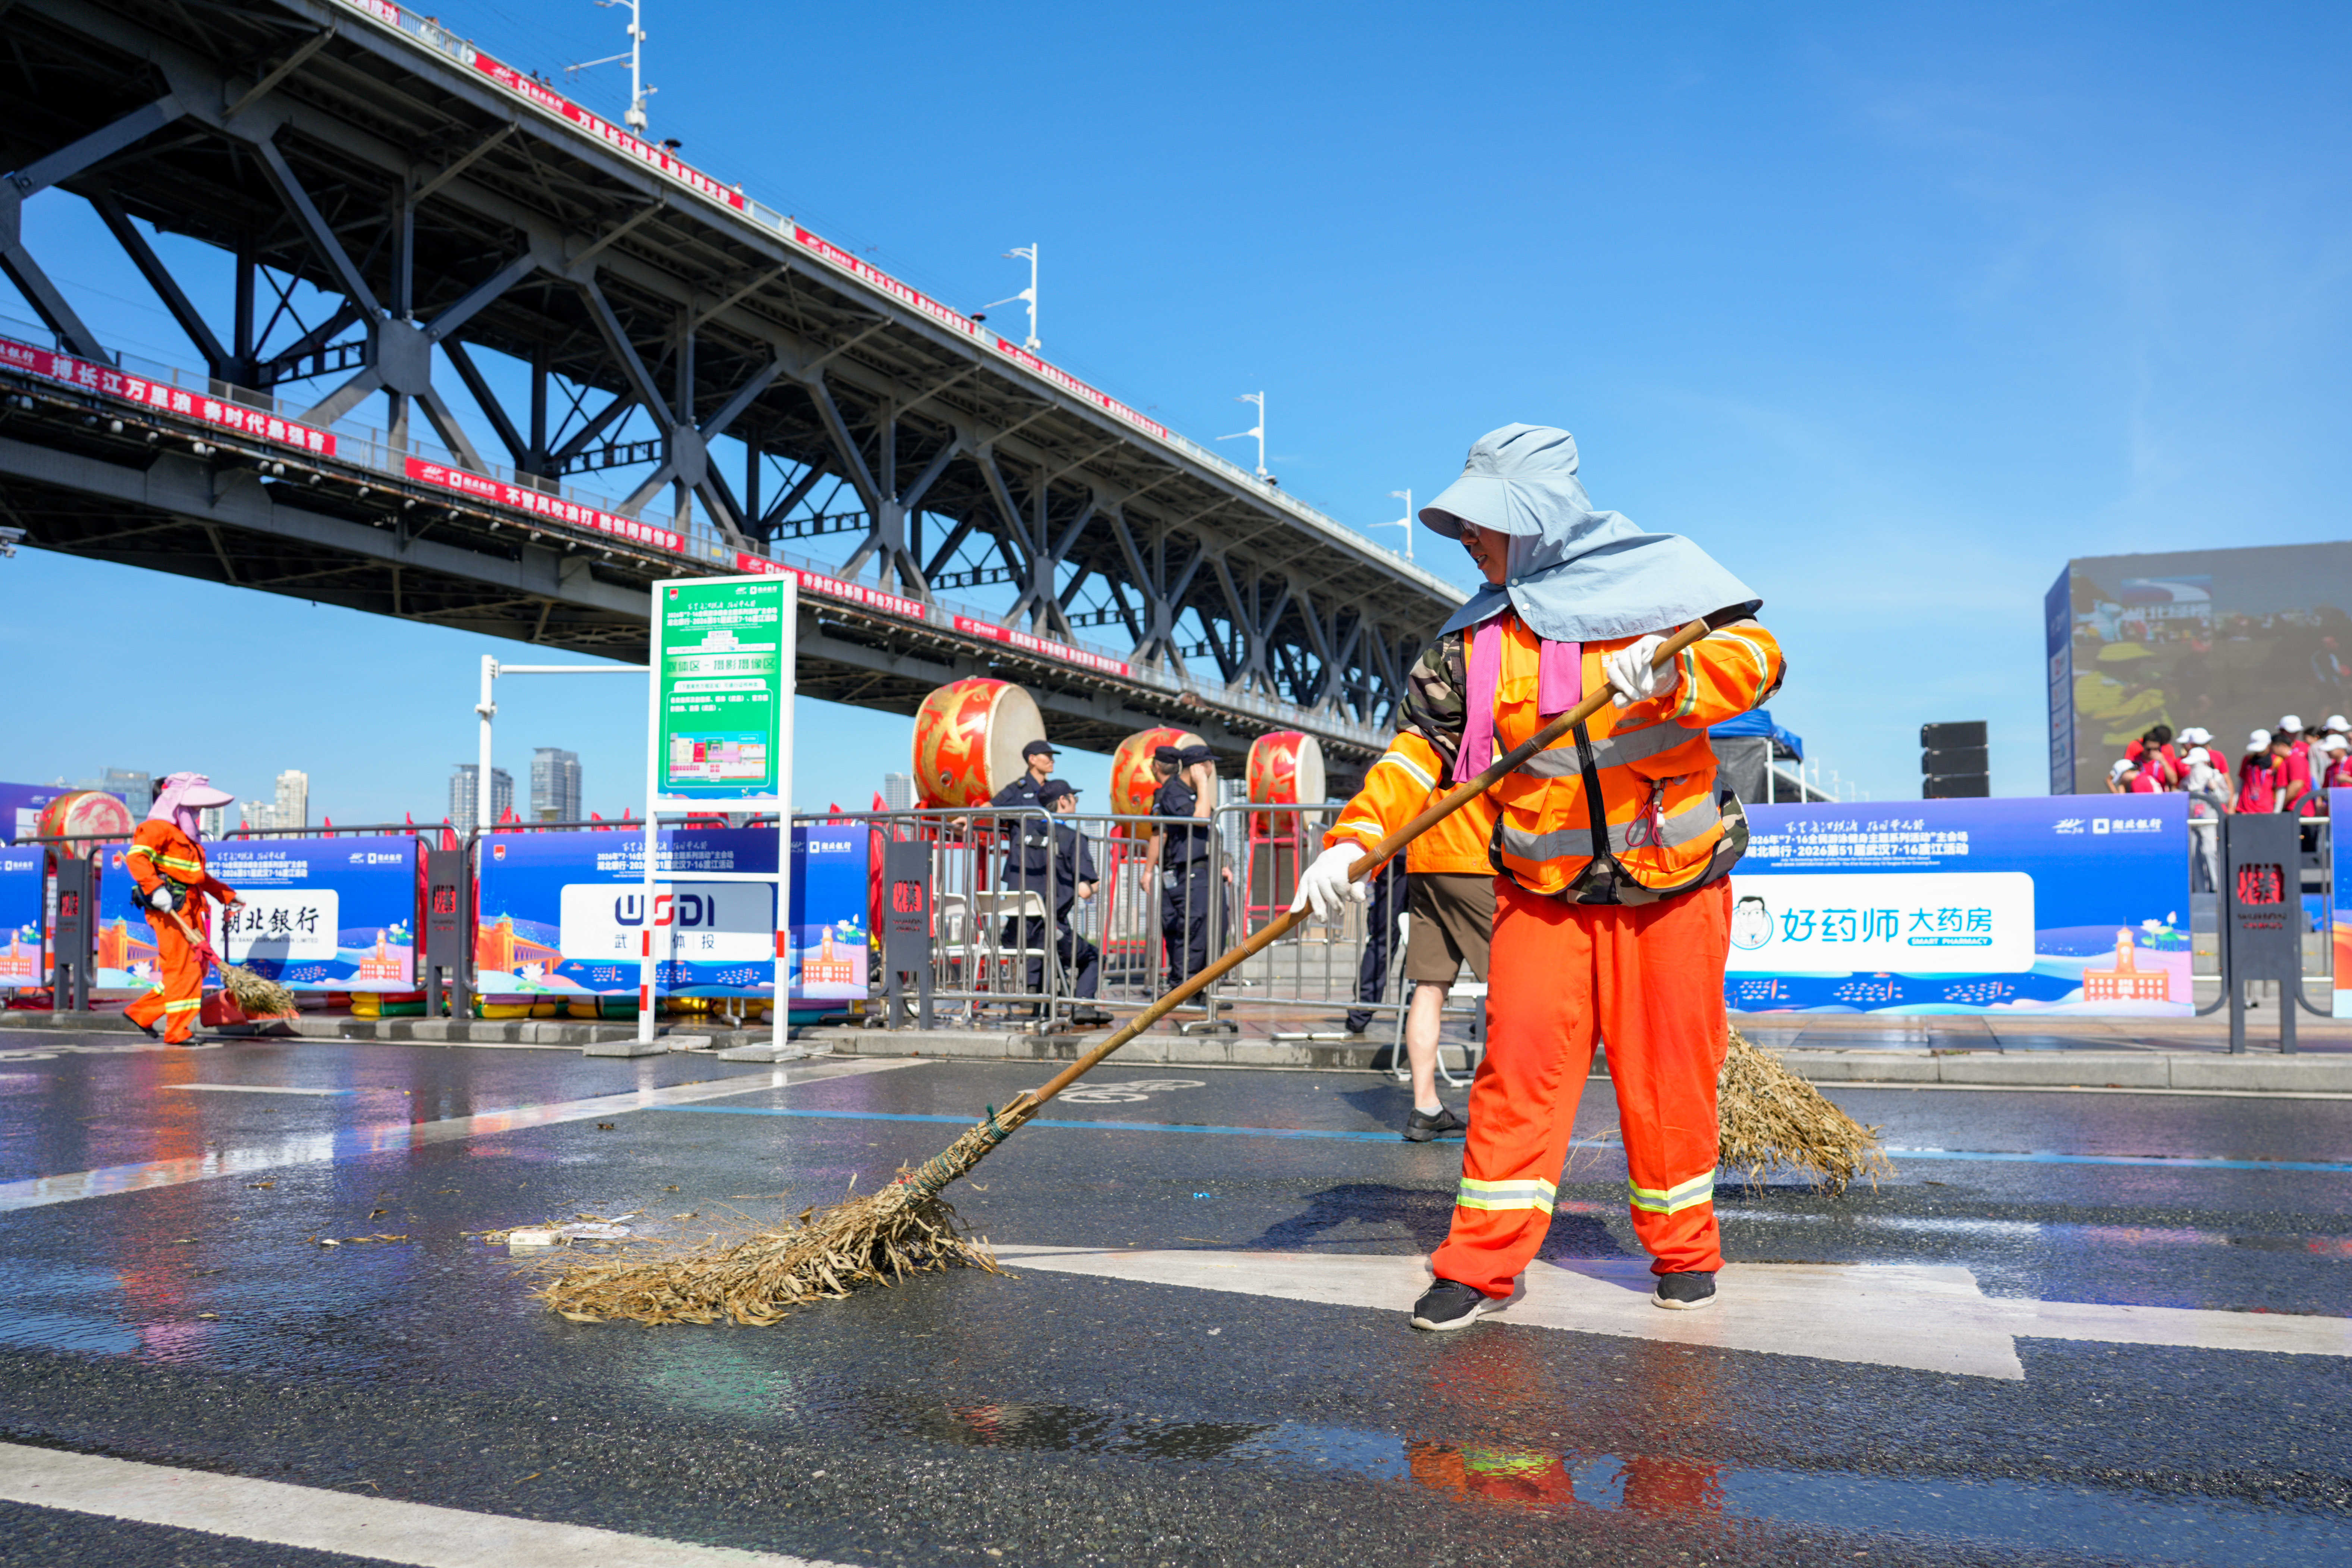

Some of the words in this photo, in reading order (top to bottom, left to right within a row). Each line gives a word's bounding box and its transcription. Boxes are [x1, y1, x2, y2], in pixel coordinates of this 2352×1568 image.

[51, 357, 192, 414] 搏长江万里浪
[203, 400, 325, 452] 奏时代最强音
[506, 487, 594, 526] 不管风吹浪打
[599, 514, 678, 548] 胜似闲庭信步
[803, 573, 863, 602] 传承红色基因
[1780, 908, 1899, 942] 好药师
[1909, 907, 1992, 931] 大药房
